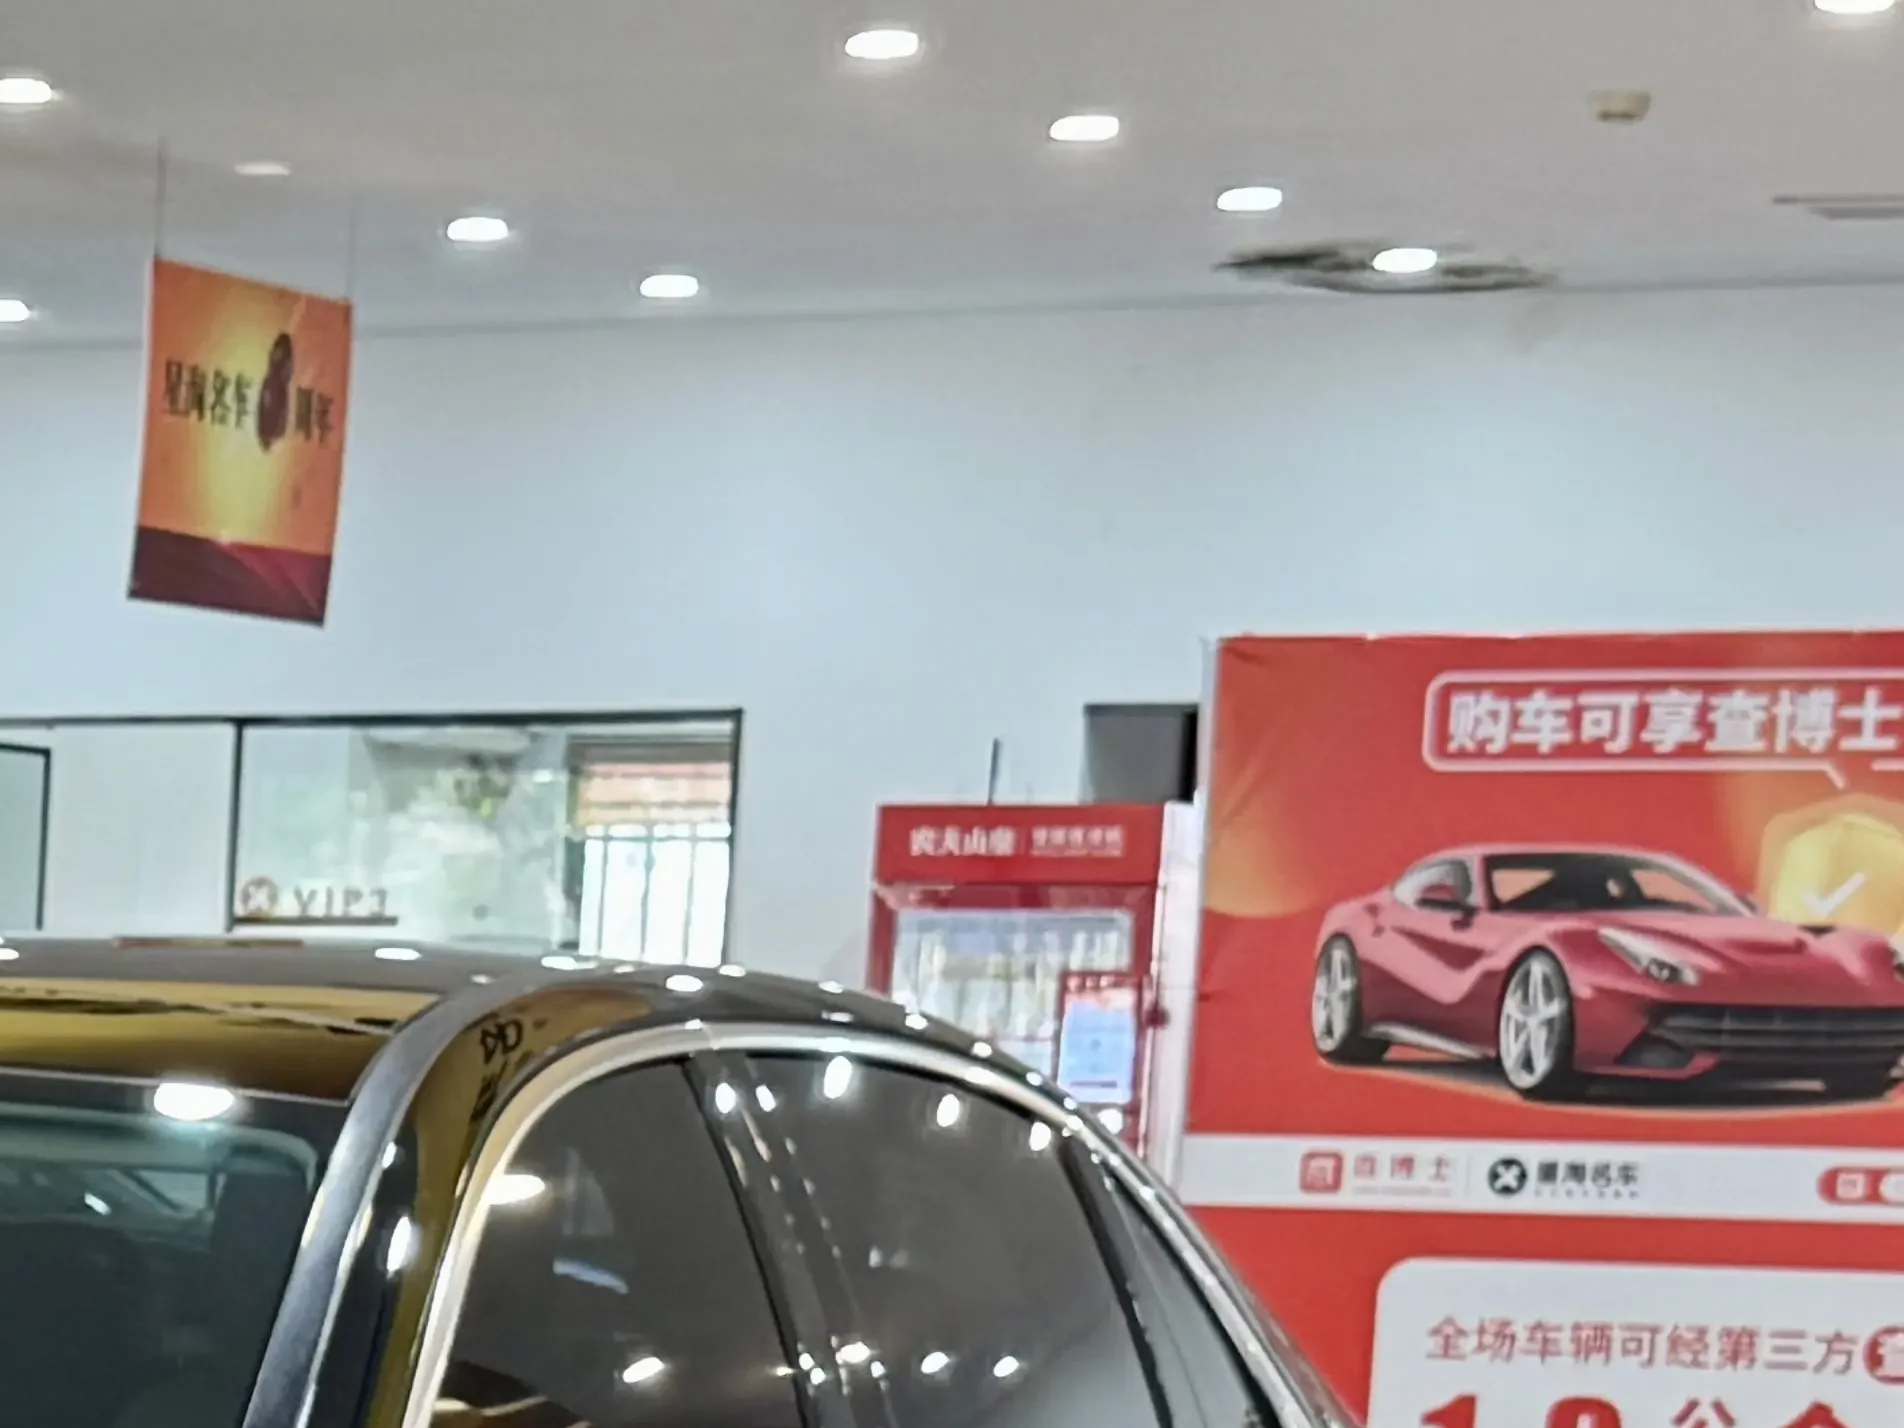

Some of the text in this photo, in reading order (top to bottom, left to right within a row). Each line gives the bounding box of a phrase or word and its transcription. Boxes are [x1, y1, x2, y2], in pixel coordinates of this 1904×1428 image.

[1446, 687, 1902, 754] 购车可享查博士
[1424, 1315, 1860, 1376] 全场车辆可经第三方
